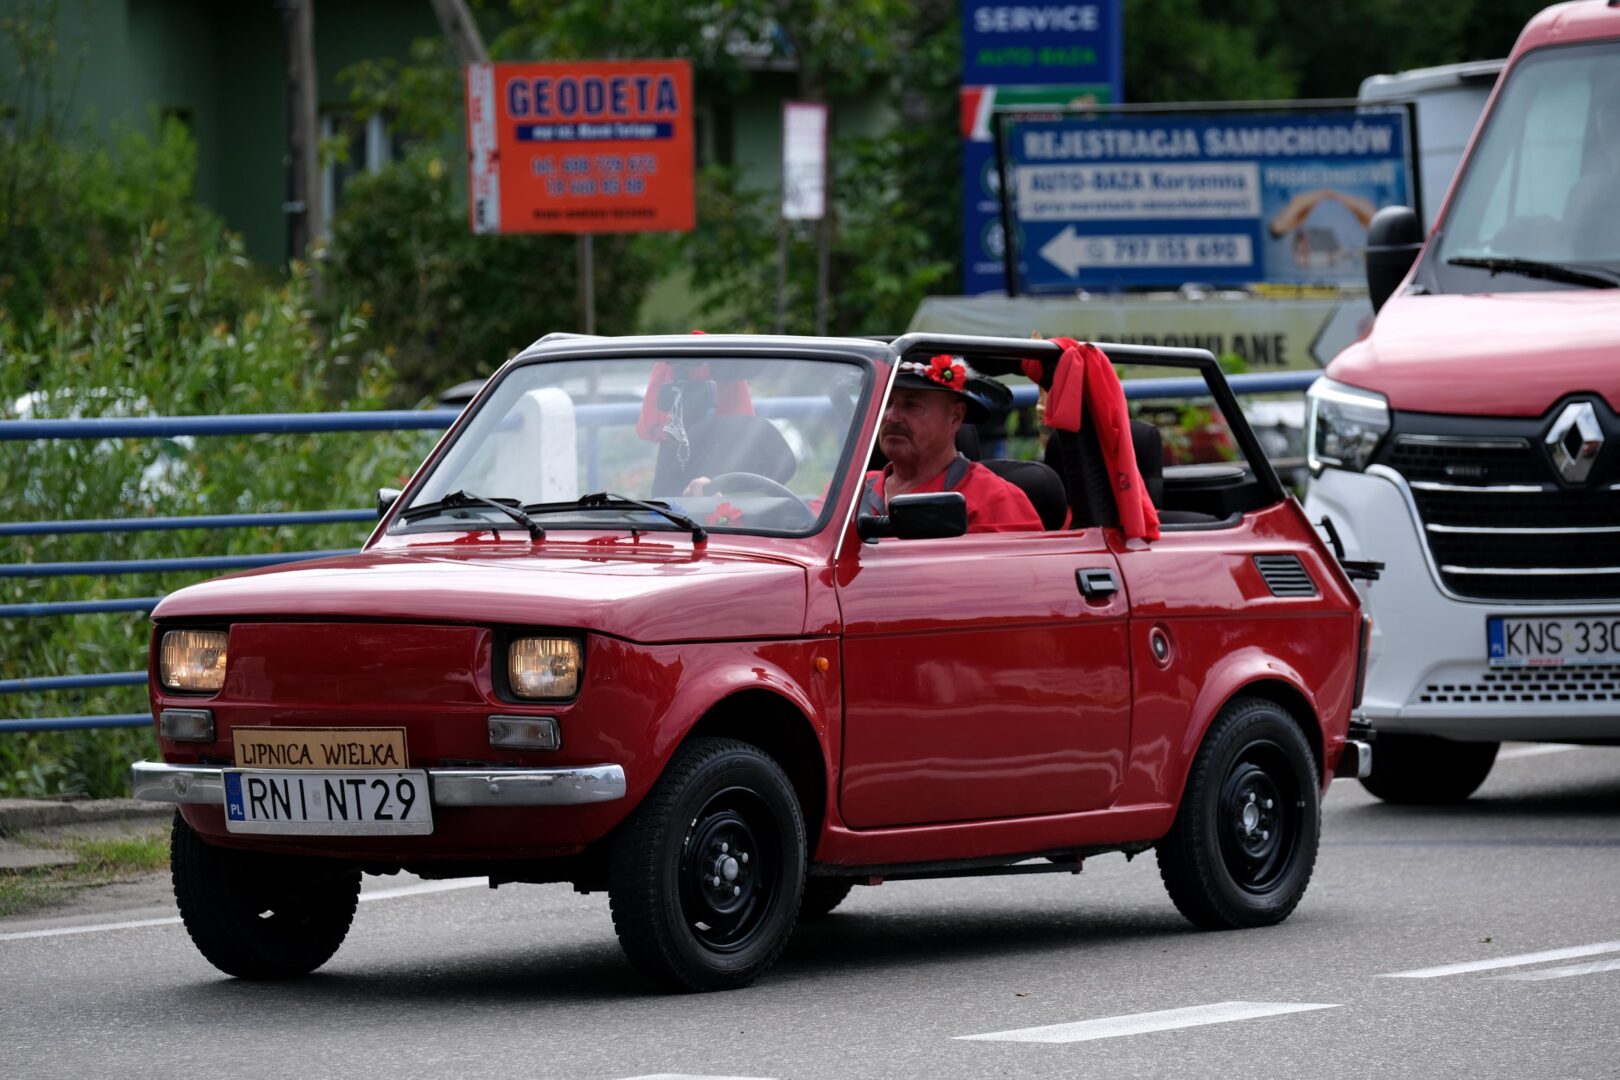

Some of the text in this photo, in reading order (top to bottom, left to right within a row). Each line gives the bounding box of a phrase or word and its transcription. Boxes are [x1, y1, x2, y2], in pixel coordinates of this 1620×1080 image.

[974, 6, 1097, 31] SERVICE
[978, 48, 1034, 66] AUTO
[507, 75, 679, 117] GEODETA
[1023, 121, 1392, 159] REJESTRACJA SAMOCHODÓW
[1030, 167, 1247, 192] AUTO-BAZA Korzenna
[1113, 237, 1237, 259] 797 155 690
[1506, 622, 1563, 655] KNS
[241, 742, 399, 766] LIPNICA WIELKA
[230, 804, 243, 816] PL
[248, 778, 416, 820] RNI NT29
